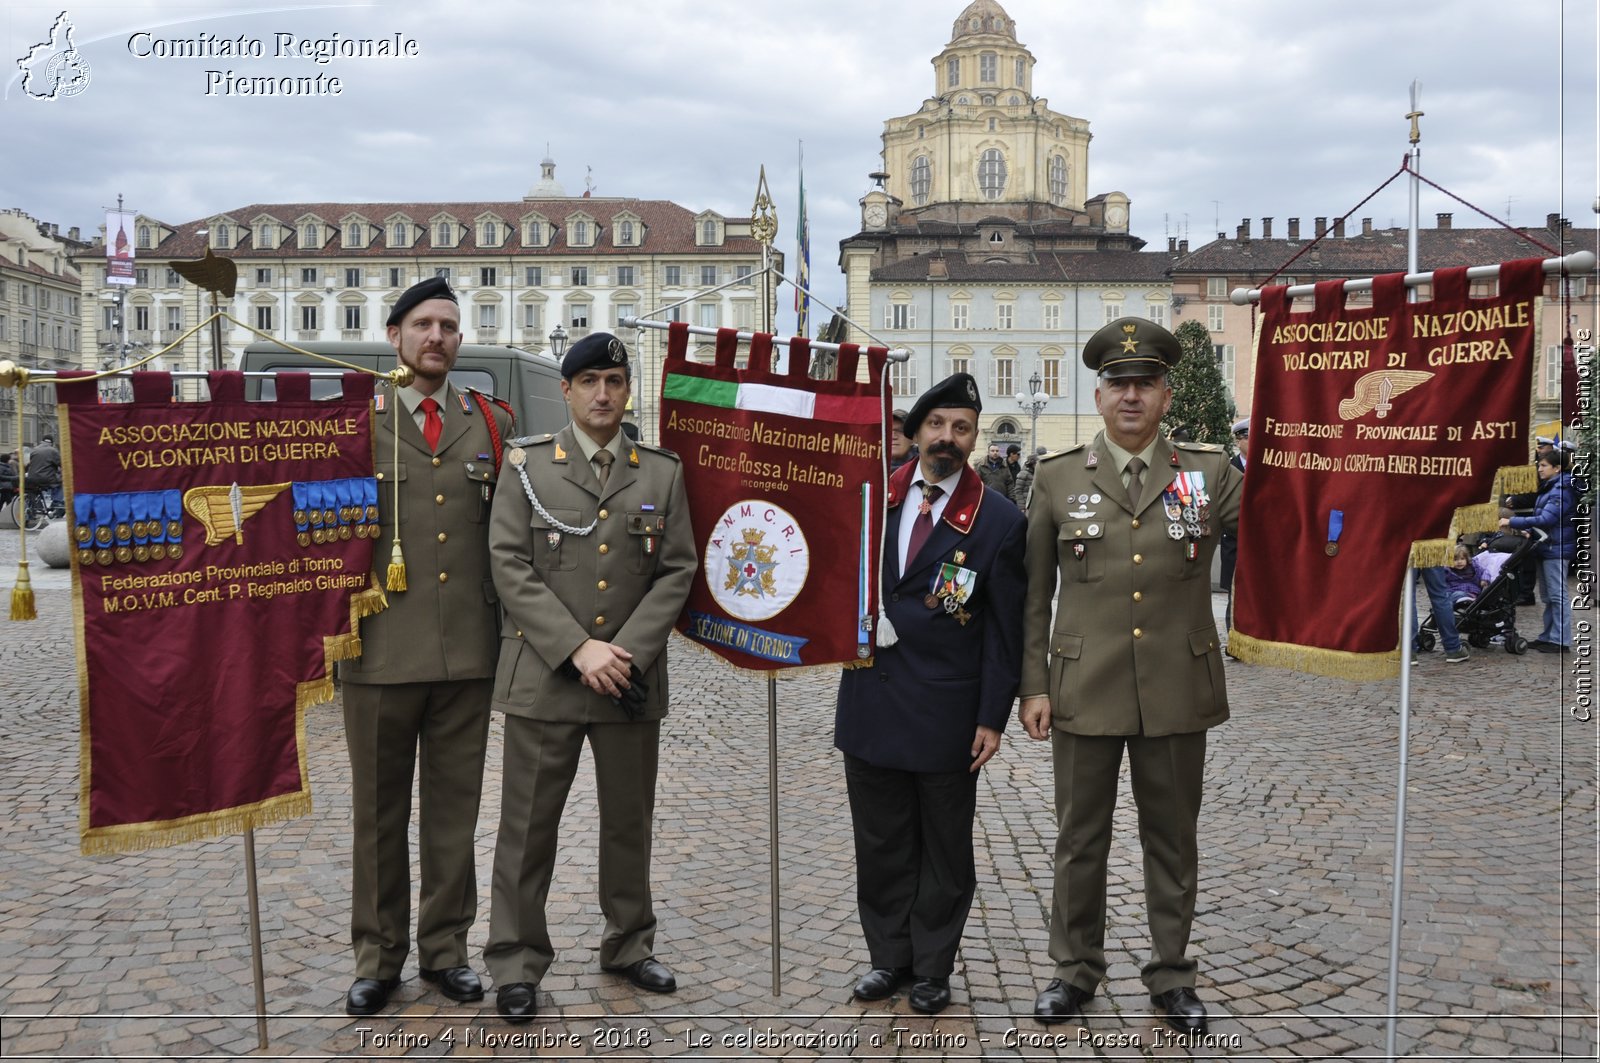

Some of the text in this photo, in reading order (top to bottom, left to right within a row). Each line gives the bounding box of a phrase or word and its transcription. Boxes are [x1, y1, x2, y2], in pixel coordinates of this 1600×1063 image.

[1272, 302, 1529, 344] ASSOCIAZIONE NAZIONALE
[1283, 338, 1513, 371] VOLONTARI DI GUERRA
[98, 419, 357, 445] ASSOCIAZIONE NAZIONALE
[666, 410, 882, 460] Associazione Nazionale Militari
[1447, 426, 1462, 442] DI
[1471, 421, 1517, 440] ASTI
[118, 442, 340, 470] VOLONTARI DI GUERRA
[698, 444, 844, 488] Croce Rossa Italiana
[1332, 458, 1342, 472] DI
[1419, 456, 1473, 477] BETTICA
[102, 556, 343, 592] Federazione Provinciale di Torino
[103, 573, 366, 613] M.O.V.M. Cent. P. Reginaldo Giuliani
[696, 618, 793, 659] SEZIONE DI TORINO
